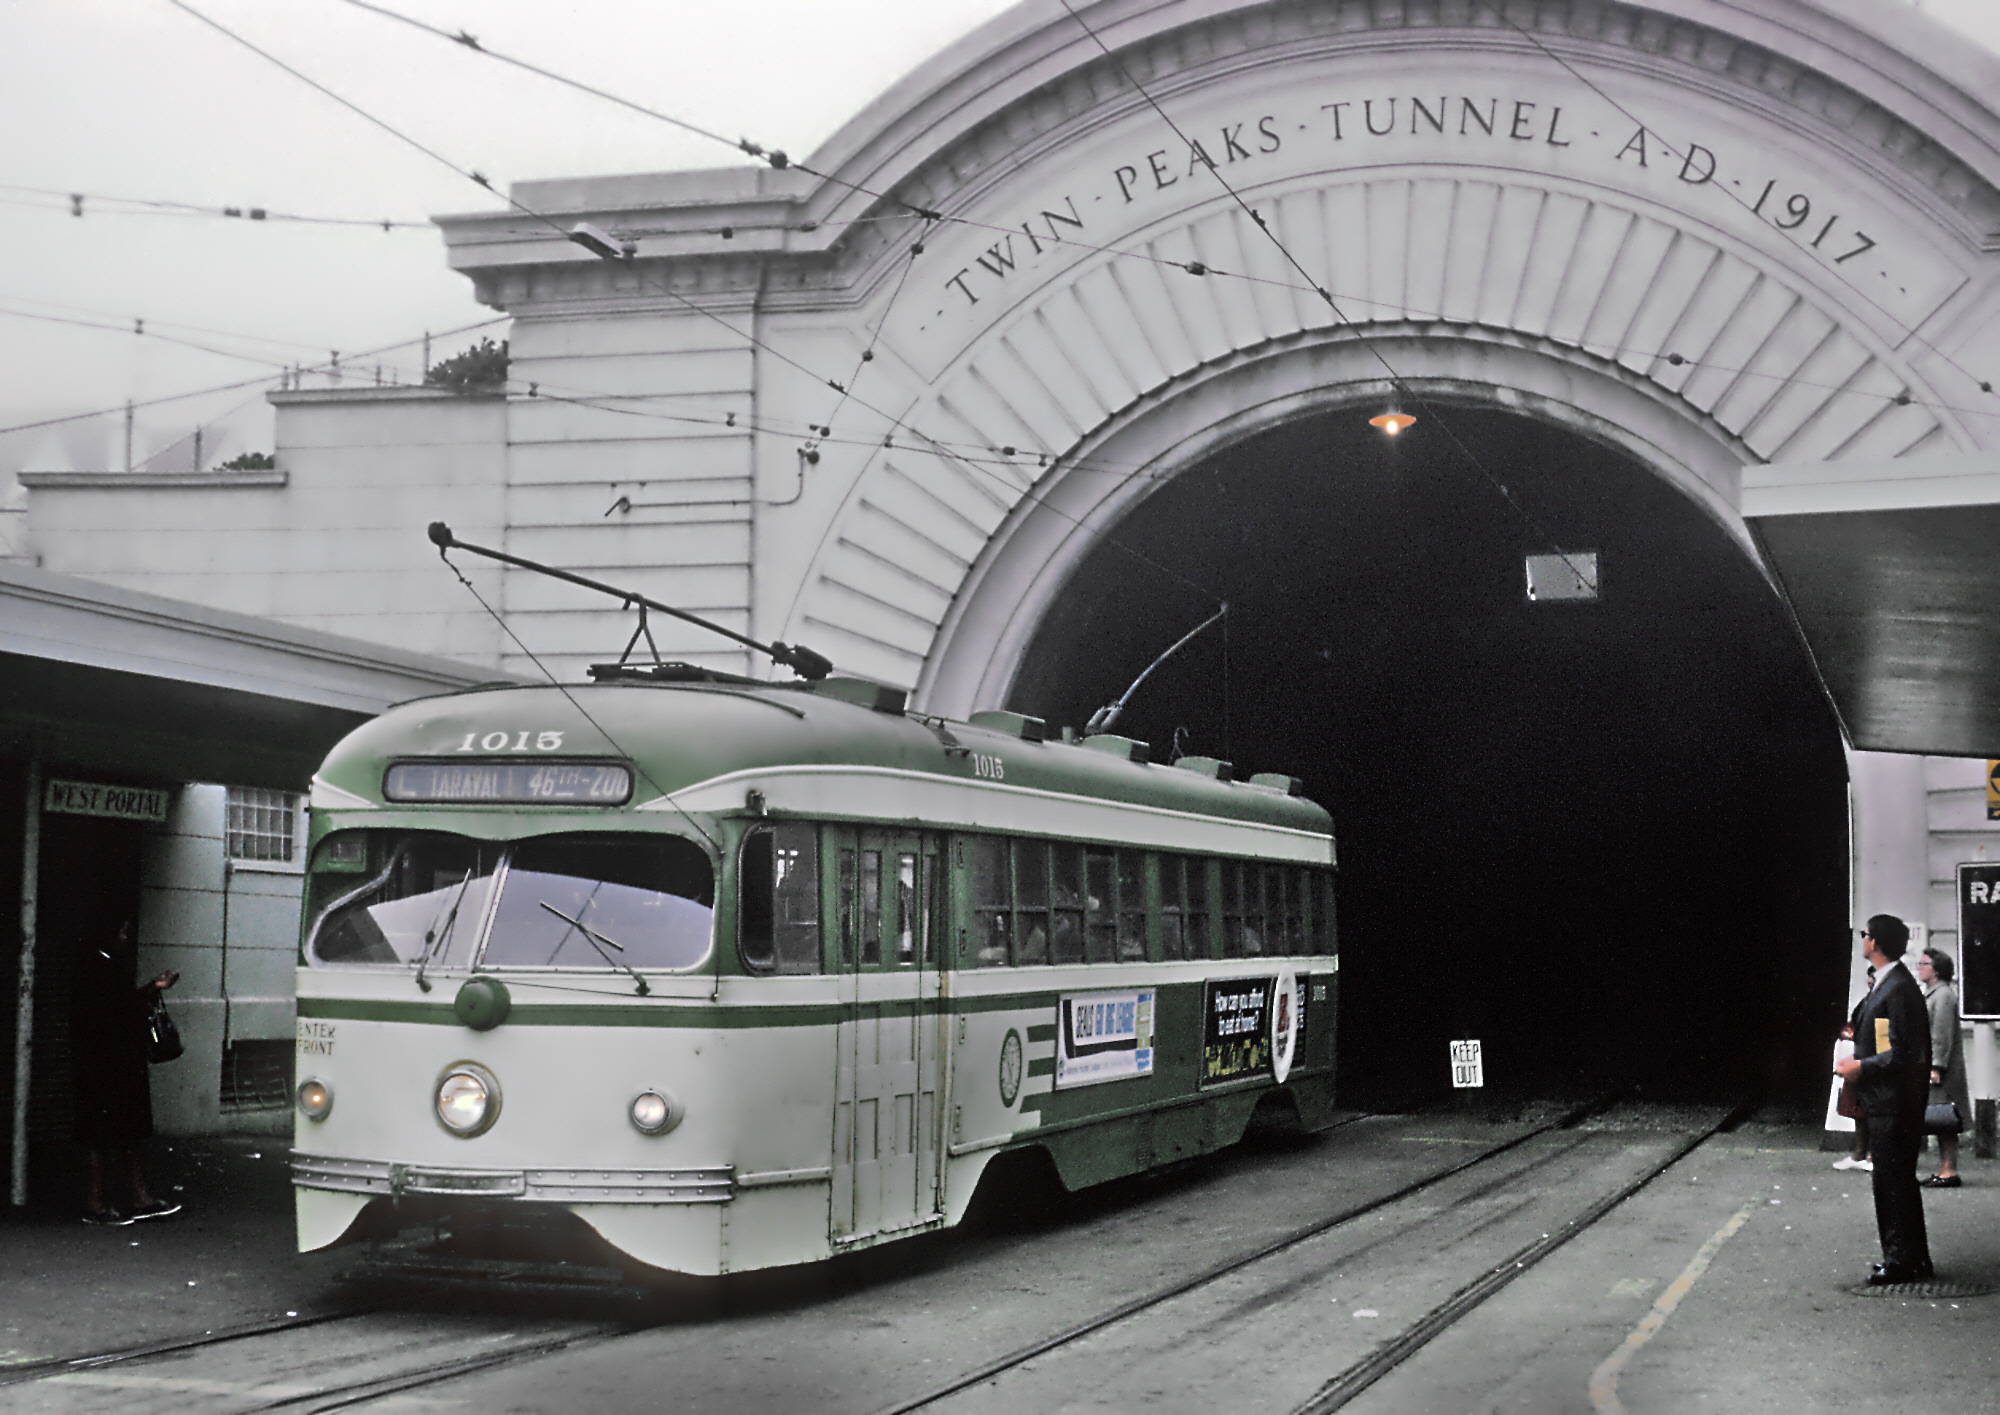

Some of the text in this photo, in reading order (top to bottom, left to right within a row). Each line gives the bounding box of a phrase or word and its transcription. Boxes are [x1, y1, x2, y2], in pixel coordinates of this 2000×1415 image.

[944, 196, 1084, 306] TWIN
[1113, 114, 1282, 203] PEAKS
[1321, 95, 1571, 147] TUNNEL
[1751, 178, 1877, 265] 1917
[457, 731, 565, 751] 1015
[973, 753, 1004, 779] 1015
[52, 784, 162, 816] WEST PORTAL
[1452, 1043, 1479, 1062] KEEP
[1456, 1065, 1477, 1084] OUT
